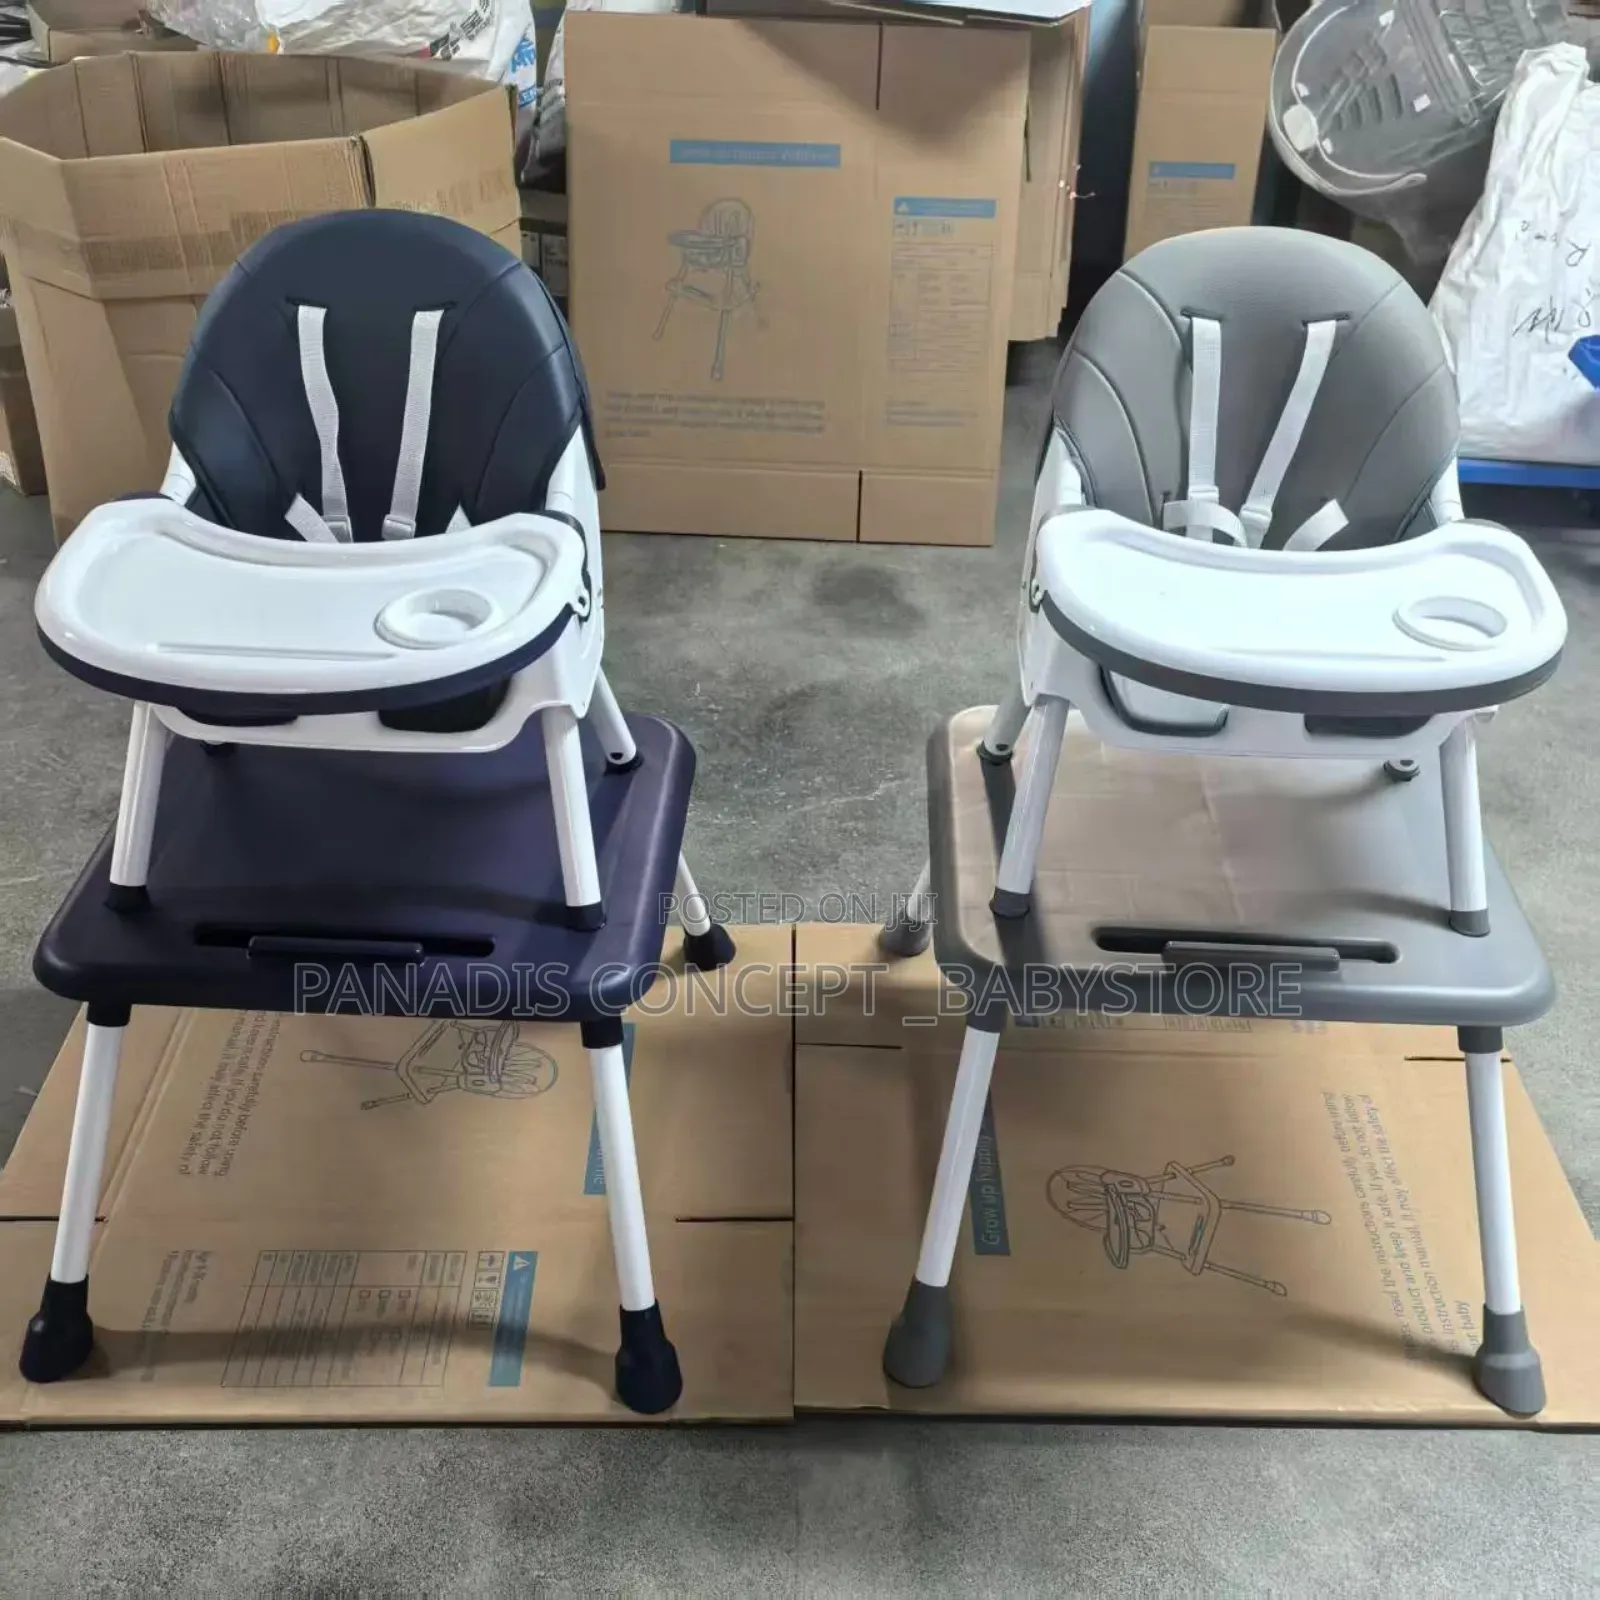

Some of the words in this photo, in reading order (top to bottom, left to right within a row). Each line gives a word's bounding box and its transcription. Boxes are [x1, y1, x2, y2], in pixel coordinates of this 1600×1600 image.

[218, 1109, 230, 1121] do
[1351, 1124, 1365, 1141] not
[1358, 1144, 1370, 1158] do
[1365, 1161, 1385, 1182] you
[979, 1185, 999, 1204] up
[1393, 1187, 1412, 1210] may
[981, 1207, 1002, 1245] Grow
[1358, 1201, 1392, 1264] instructions
[1390, 1231, 1404, 1261] keep
[1380, 1269, 1396, 1290] the
[1399, 1262, 1412, 1284] and
[1381, 1289, 1404, 1318] read
[1408, 1286, 1432, 1336] product
[1424, 1271, 1454, 1336] instruction
[1455, 1300, 1479, 1330] baby
